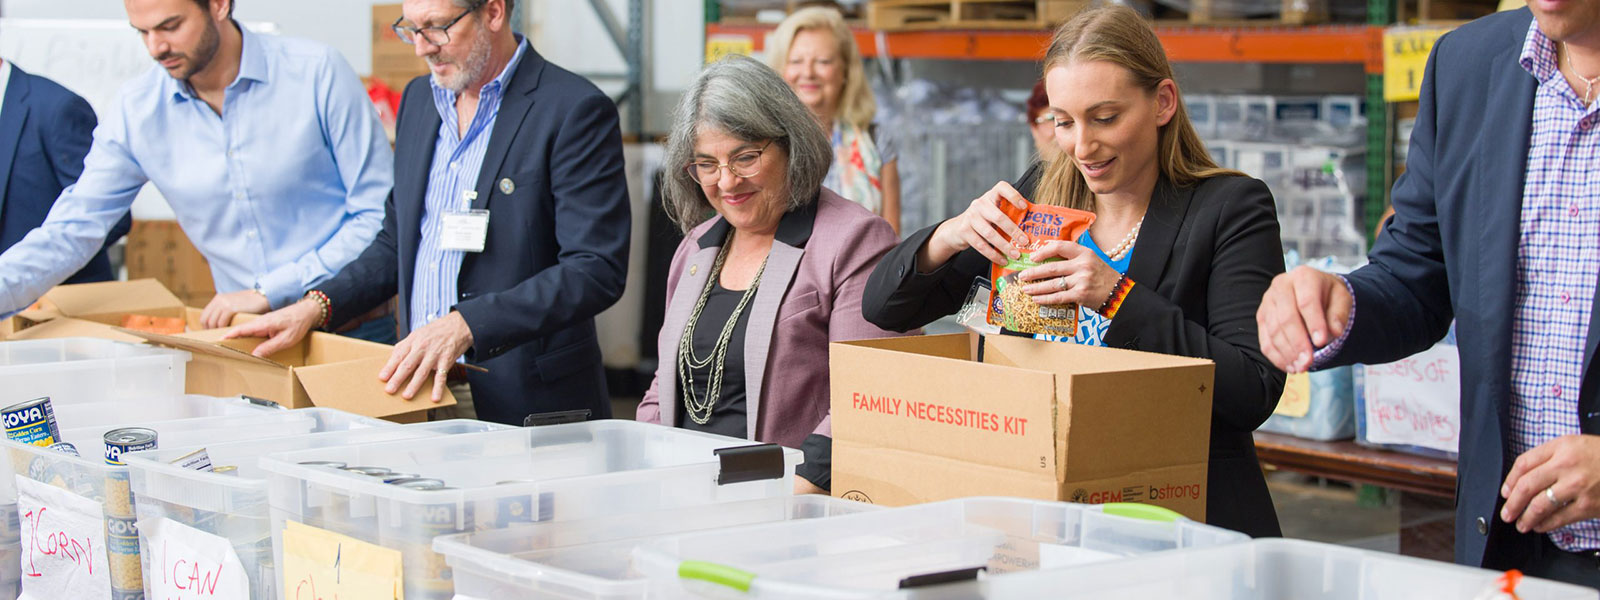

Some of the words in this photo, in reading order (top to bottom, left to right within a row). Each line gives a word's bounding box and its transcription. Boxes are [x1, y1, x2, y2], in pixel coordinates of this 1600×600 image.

[1424, 358, 1450, 382] OF
[2, 406, 42, 429] GOYA
[852, 391, 902, 416] FAMILY
[906, 400, 999, 432] NECESSITIES
[1004, 415, 1028, 436] KIT
[1039, 456, 1047, 468] US
[1149, 484, 1200, 500] bstrong
[35, 507, 94, 576] CORN
[173, 559, 223, 596] CAN
